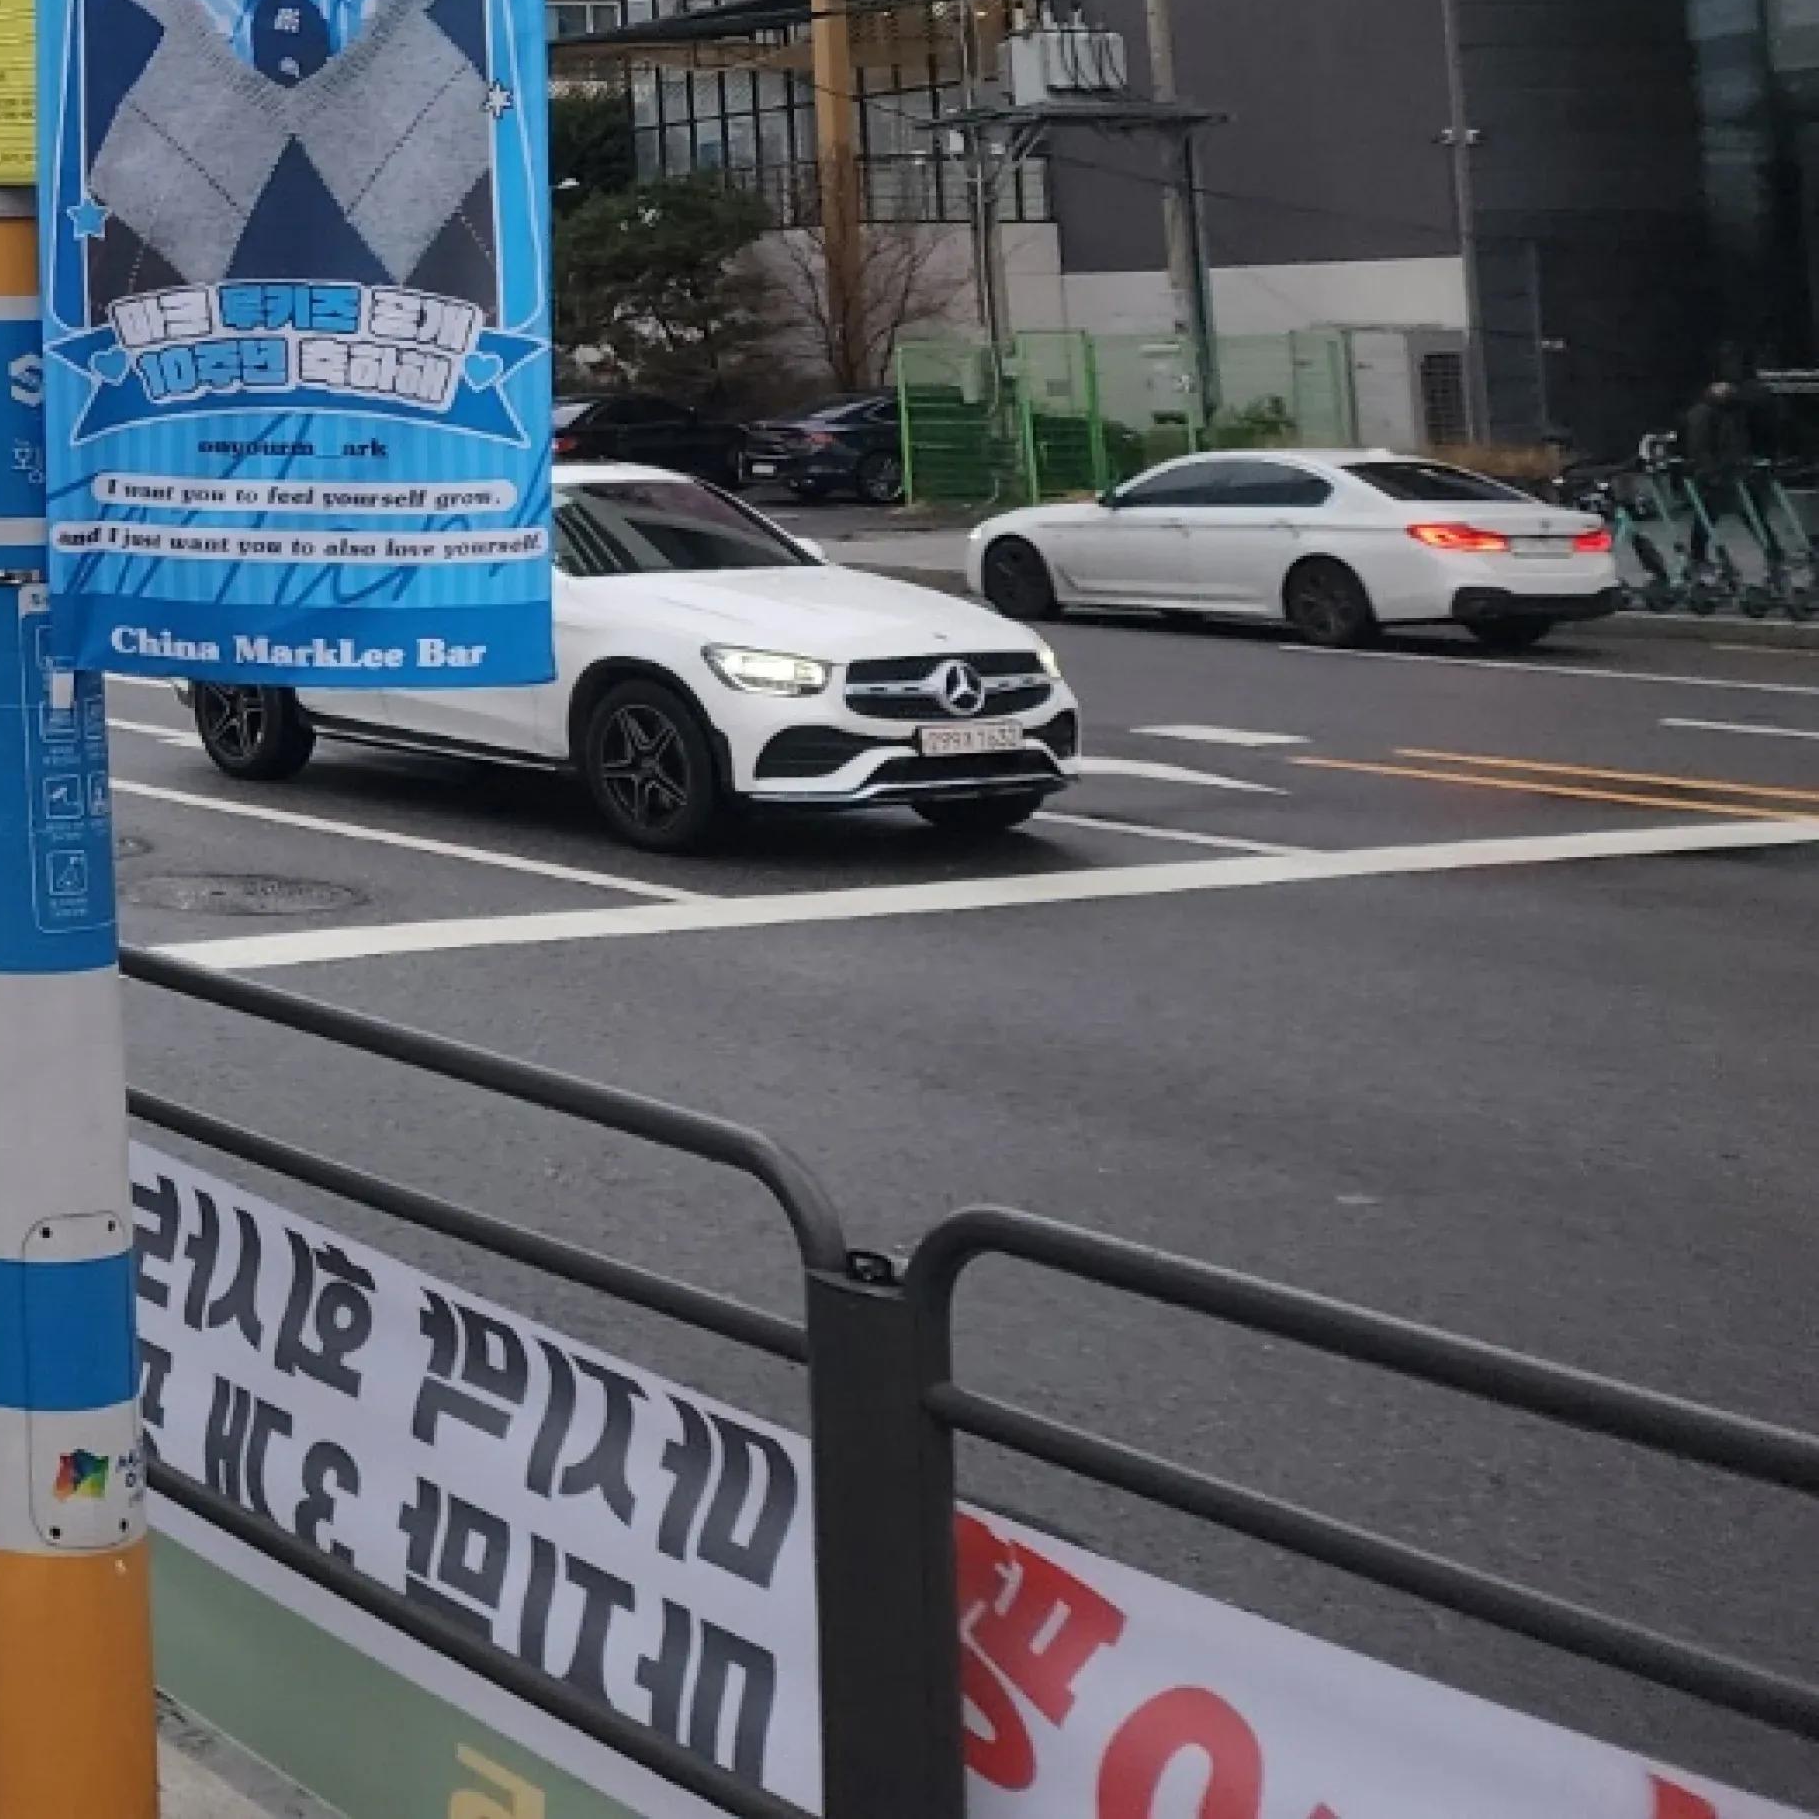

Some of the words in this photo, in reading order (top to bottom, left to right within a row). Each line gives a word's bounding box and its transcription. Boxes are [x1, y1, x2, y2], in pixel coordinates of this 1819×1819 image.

[217, 283, 363, 334] 루키즈
[137, 338, 289, 402] 10주년
[107, 479, 117, 494] I
[124, 484, 175, 500] want
[181, 489, 226, 506] you
[235, 488, 259, 504] to
[267, 485, 315, 506] feel
[322, 489, 428, 510] yourself
[56, 526, 102, 546] and
[170, 536, 230, 553] want
[237, 539, 282, 557] you
[291, 538, 316, 556] to
[323, 538, 378, 558] also
[385, 538, 435, 558] love
[111, 626, 220, 662] China
[234, 633, 404, 669] MarkLee
[416, 638, 487, 668] Bar
